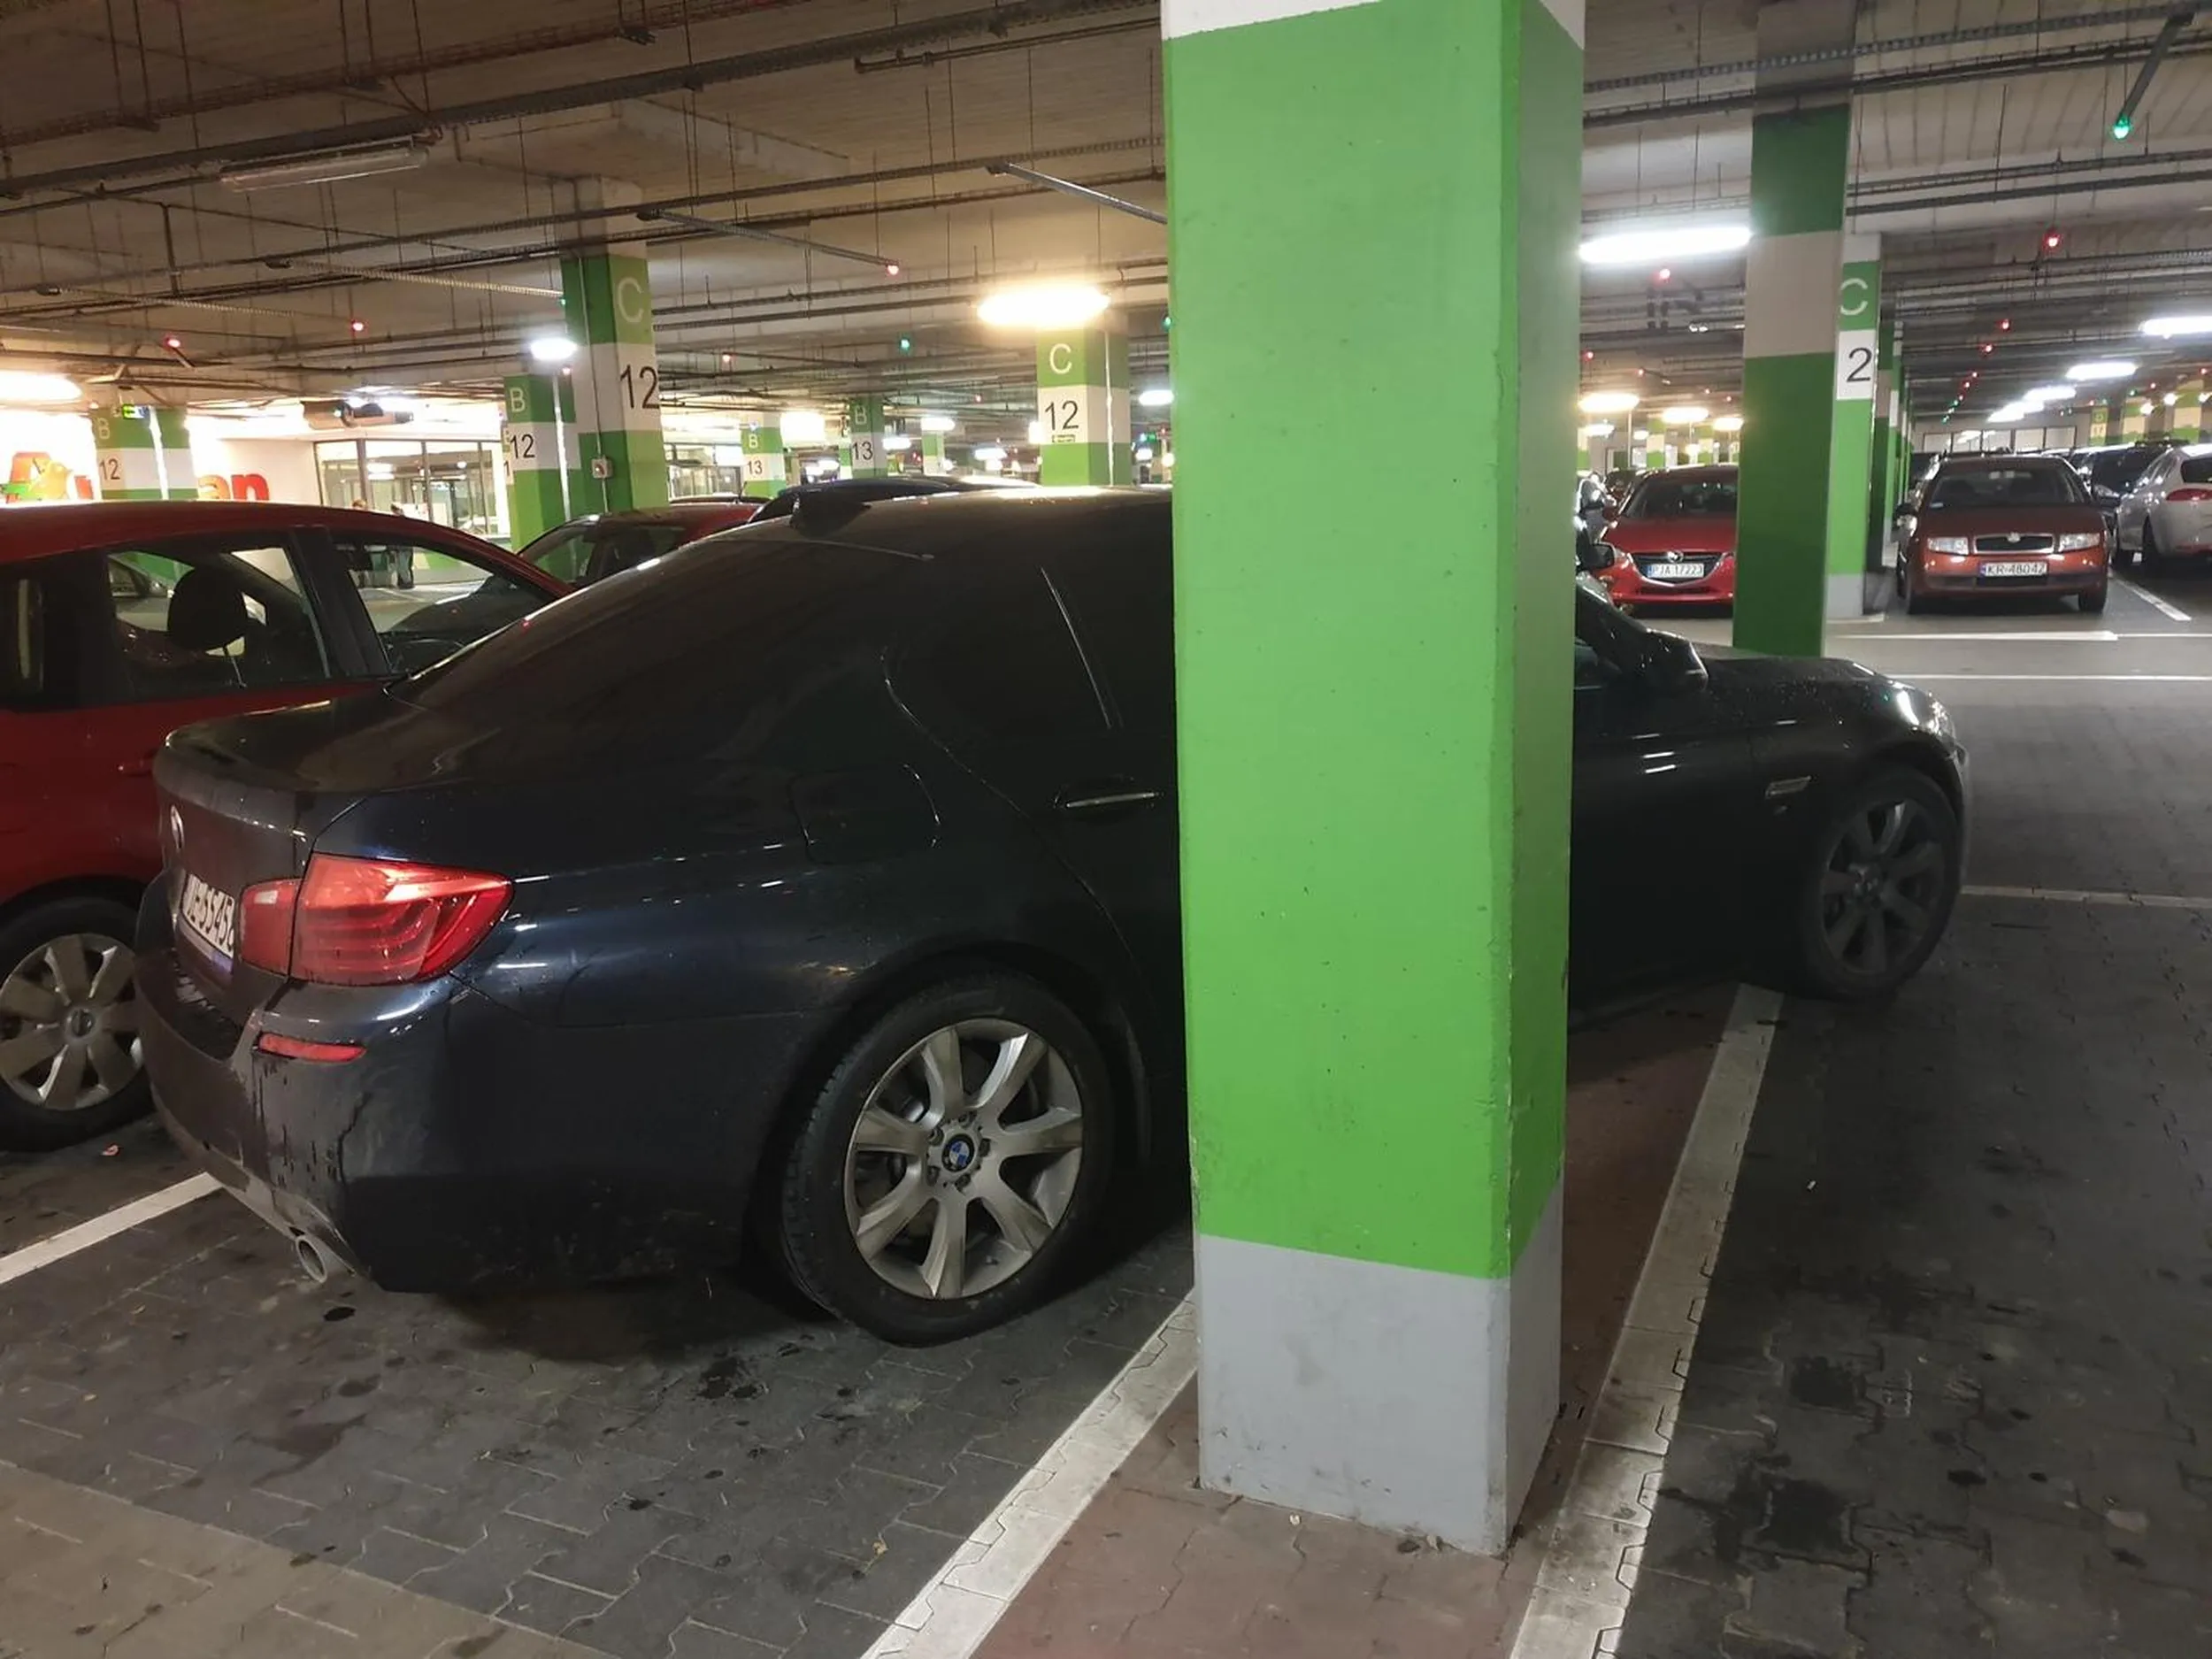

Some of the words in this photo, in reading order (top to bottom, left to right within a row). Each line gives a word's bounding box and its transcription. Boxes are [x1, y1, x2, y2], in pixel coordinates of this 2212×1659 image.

[618, 277, 644, 323] C
[1839, 277, 1869, 316] C
[1049, 343, 1072, 374] C
[620, 365, 660, 409] 12
[510, 388, 526, 412] B
[855, 404, 868, 425] B
[1045, 401, 1079, 431] 12
[97, 418, 111, 440] B
[749, 433, 759, 449] B
[511, 434, 536, 459] 12
[852, 442, 874, 461] 13
[99, 458, 120, 480] 12
[747, 460, 764, 475] 13
